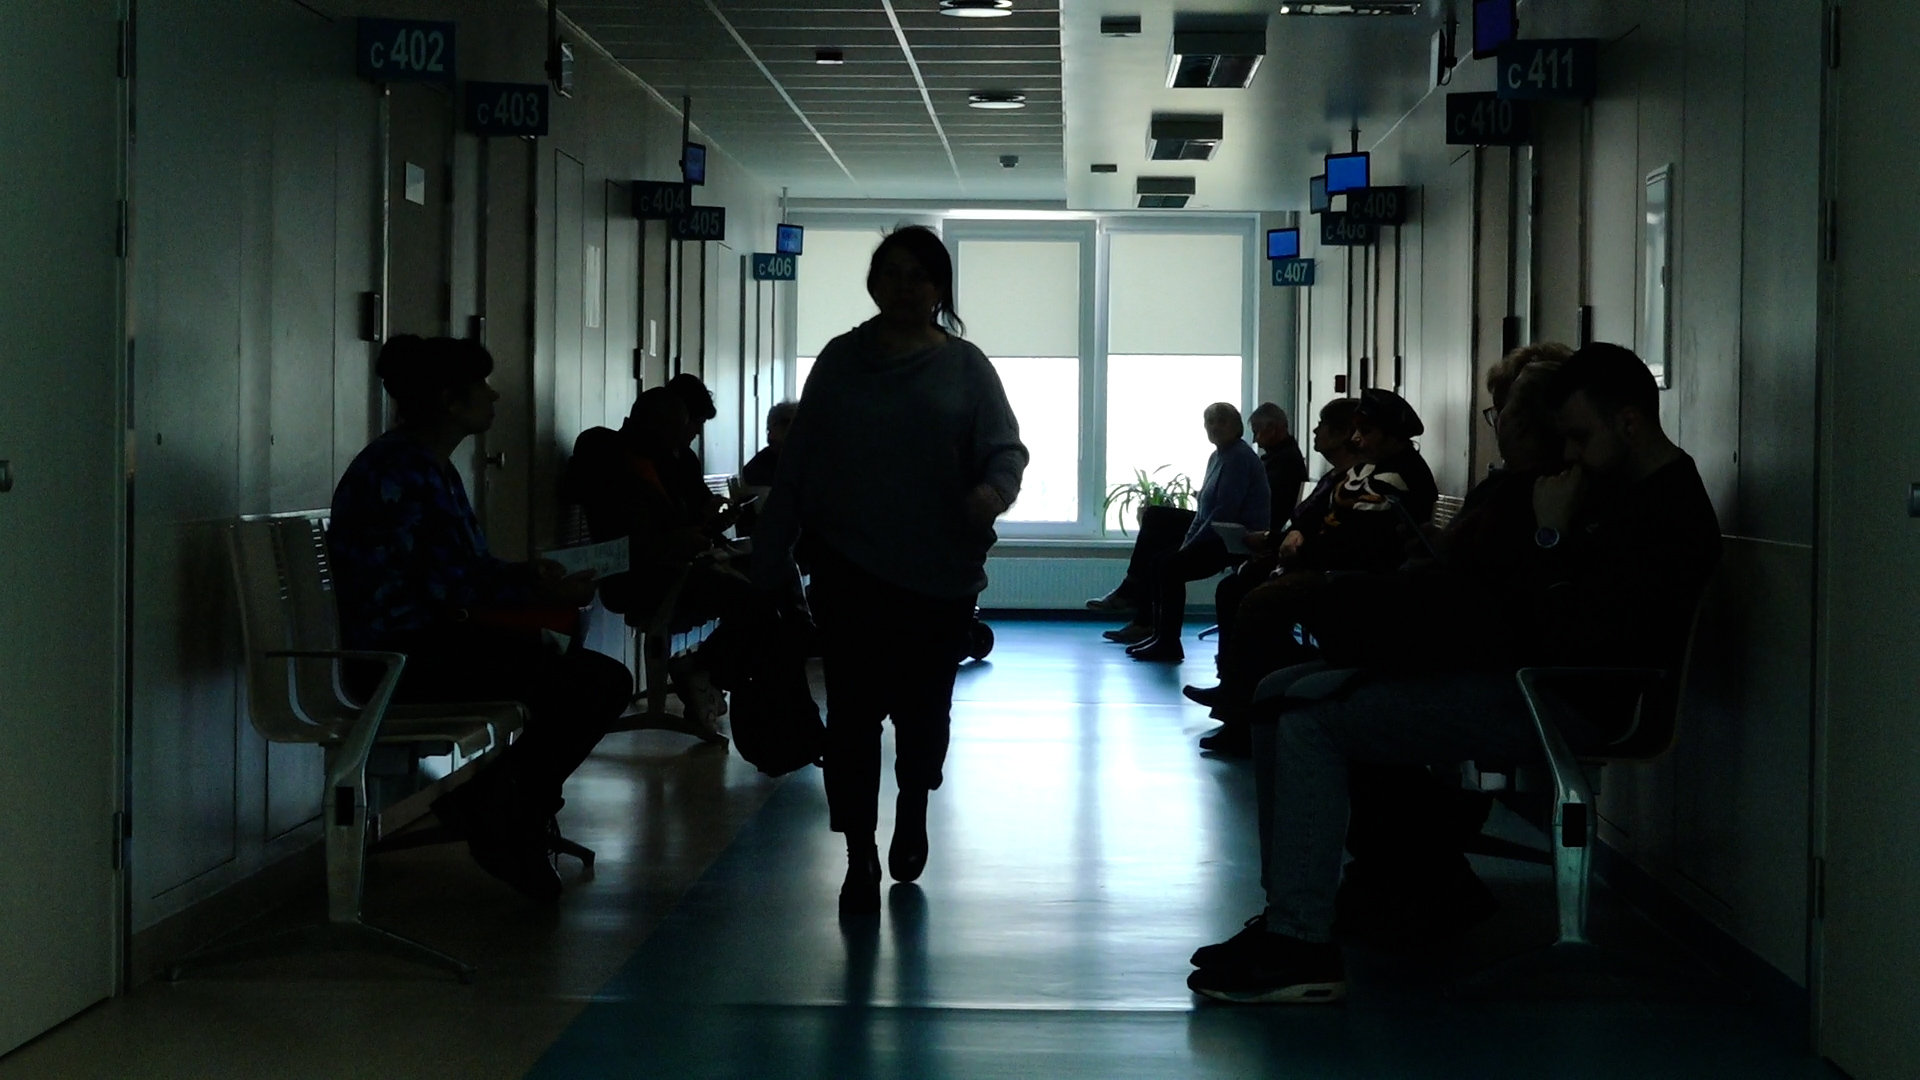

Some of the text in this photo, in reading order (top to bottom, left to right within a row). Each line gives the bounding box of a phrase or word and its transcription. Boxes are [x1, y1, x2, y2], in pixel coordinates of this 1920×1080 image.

[390, 28, 445, 72] 402
[1527, 47, 1574, 89] 411
[494, 90, 540, 127] 403
[1470, 99, 1513, 135] 410
[652, 187, 686, 213] 404
[1364, 191, 1398, 219] 409
[690, 210, 720, 236] 405
[767, 256, 792, 277] 406
[1284, 262, 1308, 282] 407
